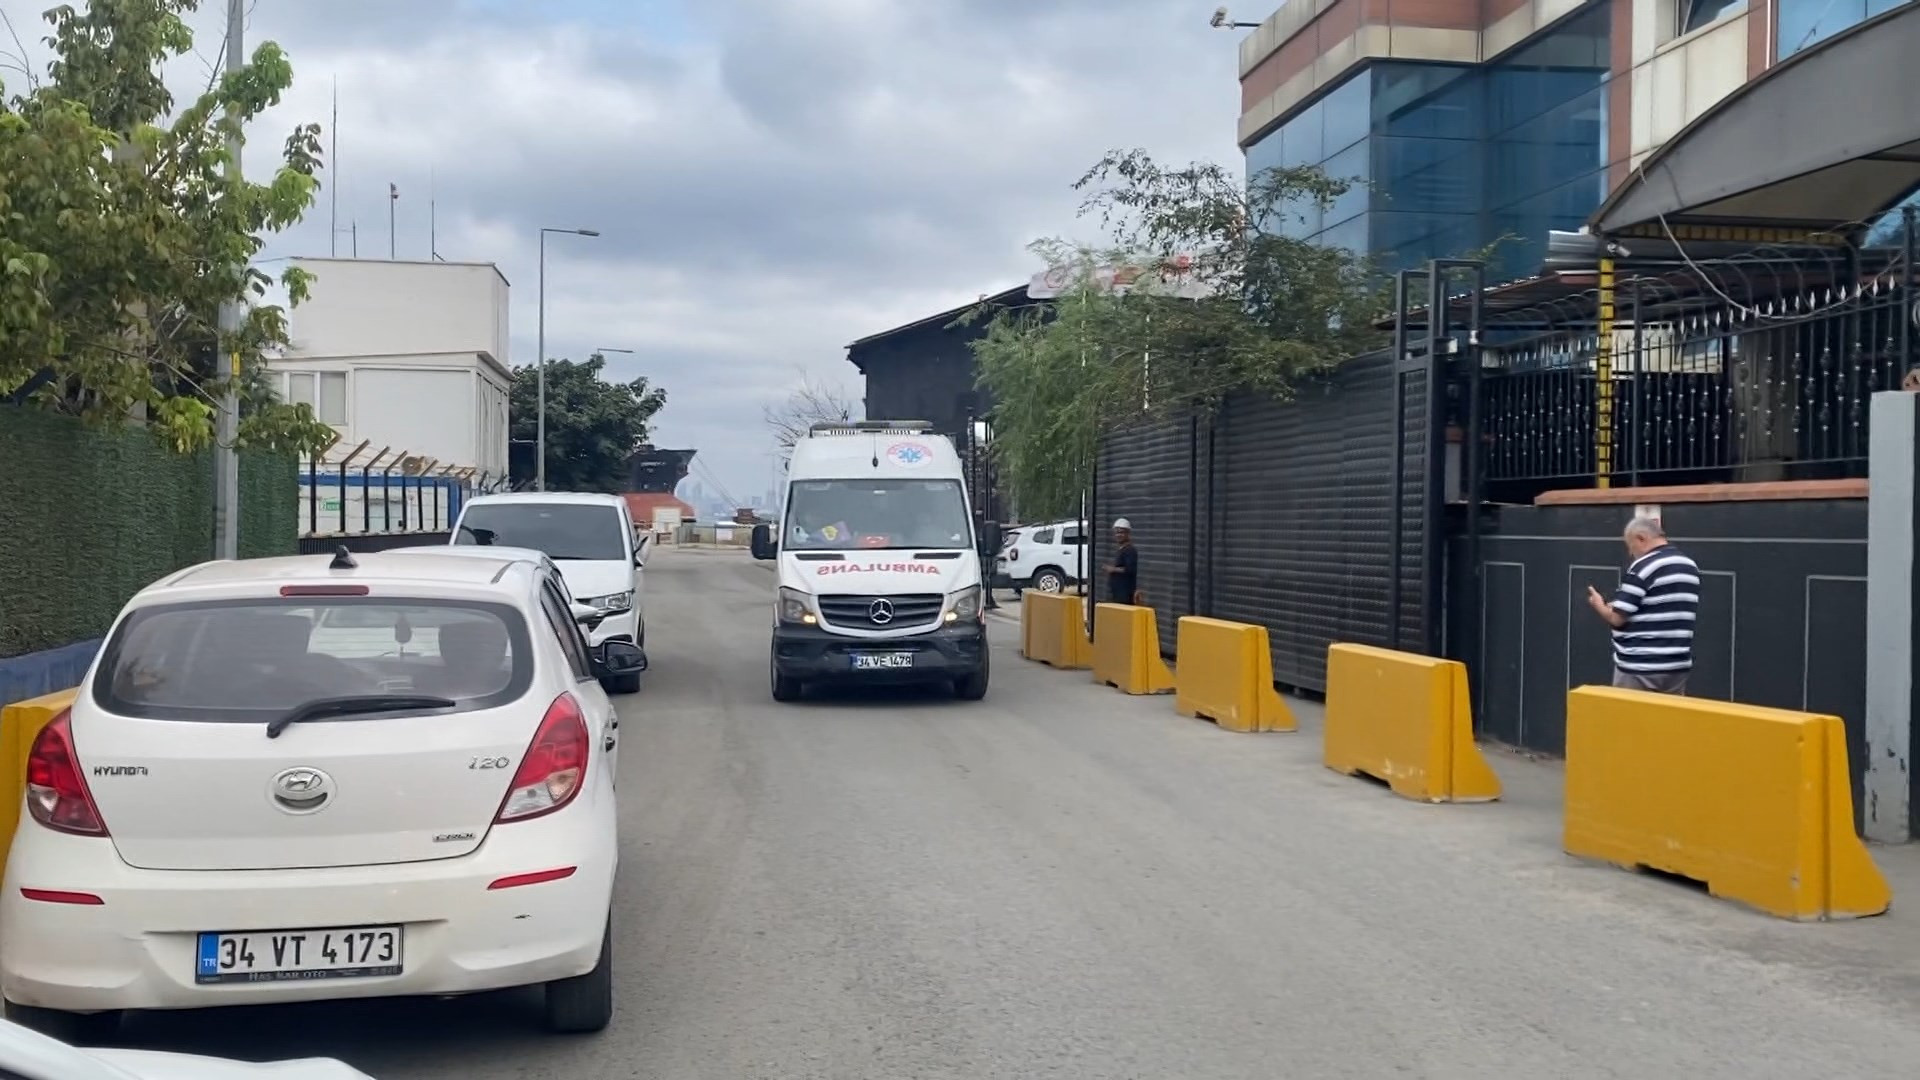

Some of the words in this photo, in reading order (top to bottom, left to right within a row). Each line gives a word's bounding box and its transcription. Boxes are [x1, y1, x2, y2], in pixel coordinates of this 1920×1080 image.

[858, 657, 870, 667] 34
[873, 656, 888, 666] VE
[468, 756, 511, 770] i20
[93, 765, 149, 777] HYUNDAI
[220, 937, 255, 969] 34
[272, 936, 306, 967] VT
[321, 932, 394, 964] 4173
[203, 958, 217, 967] TR
